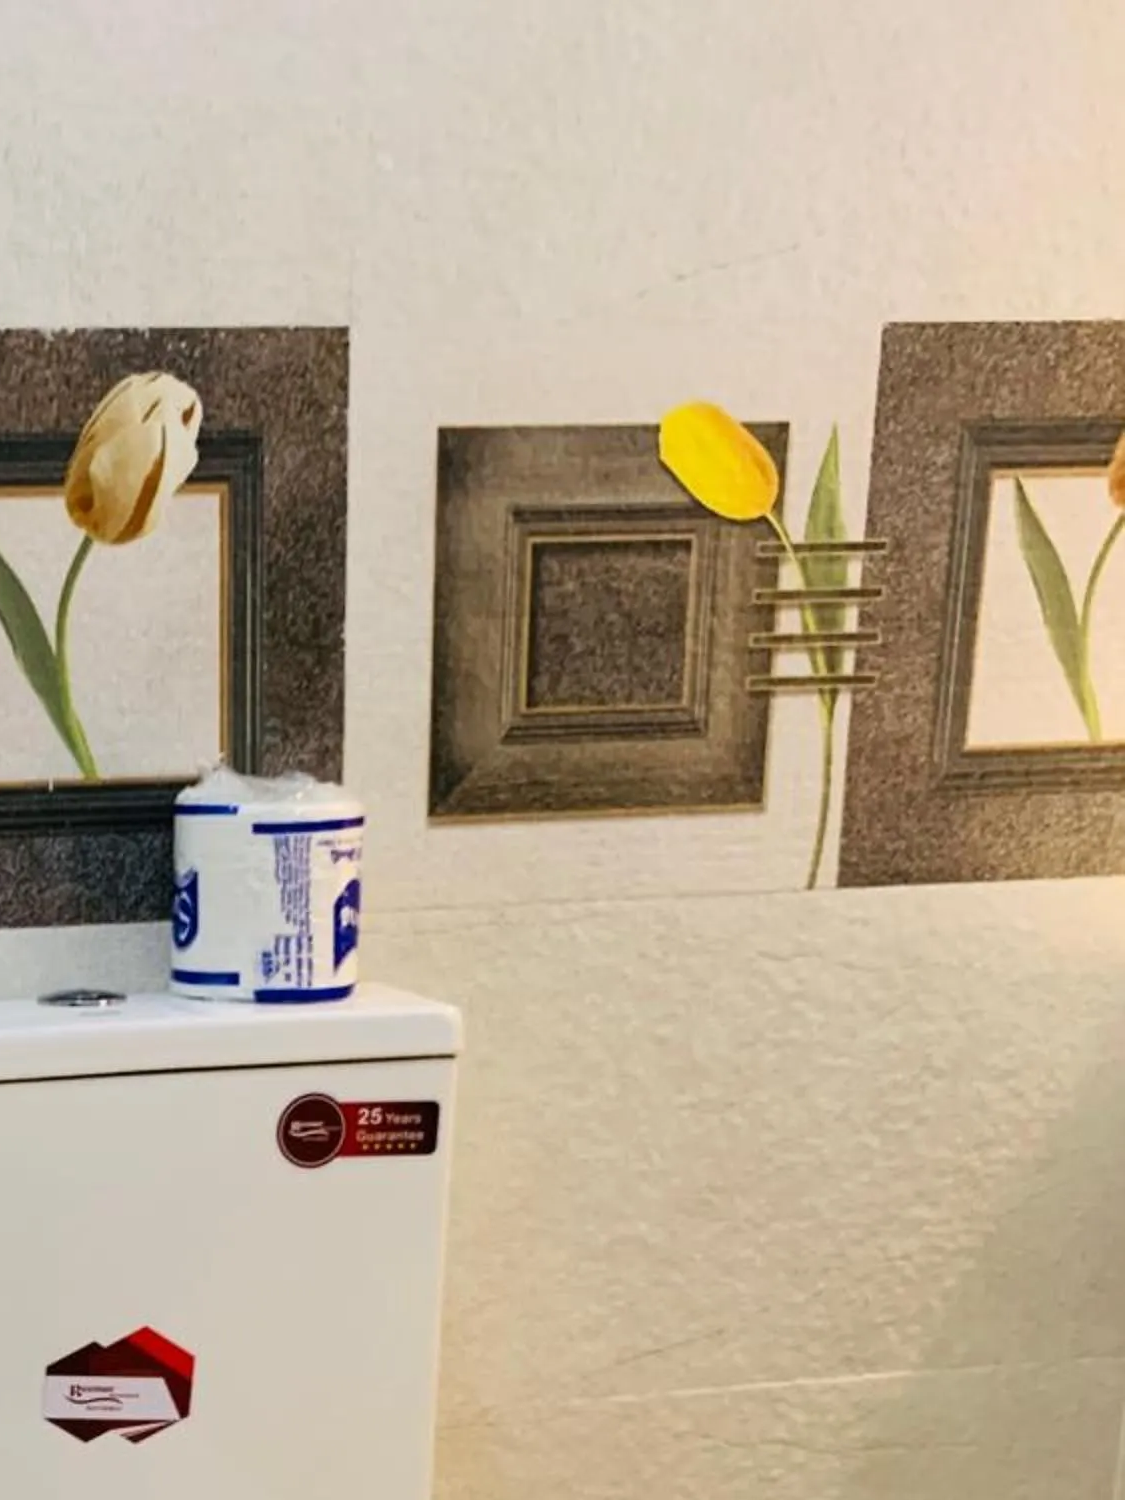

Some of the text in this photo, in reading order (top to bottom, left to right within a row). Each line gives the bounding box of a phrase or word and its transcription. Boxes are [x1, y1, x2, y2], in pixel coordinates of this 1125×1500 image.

[357, 1107, 422, 1125] 25 Years
[355, 1128, 425, 1142] Guarantee
